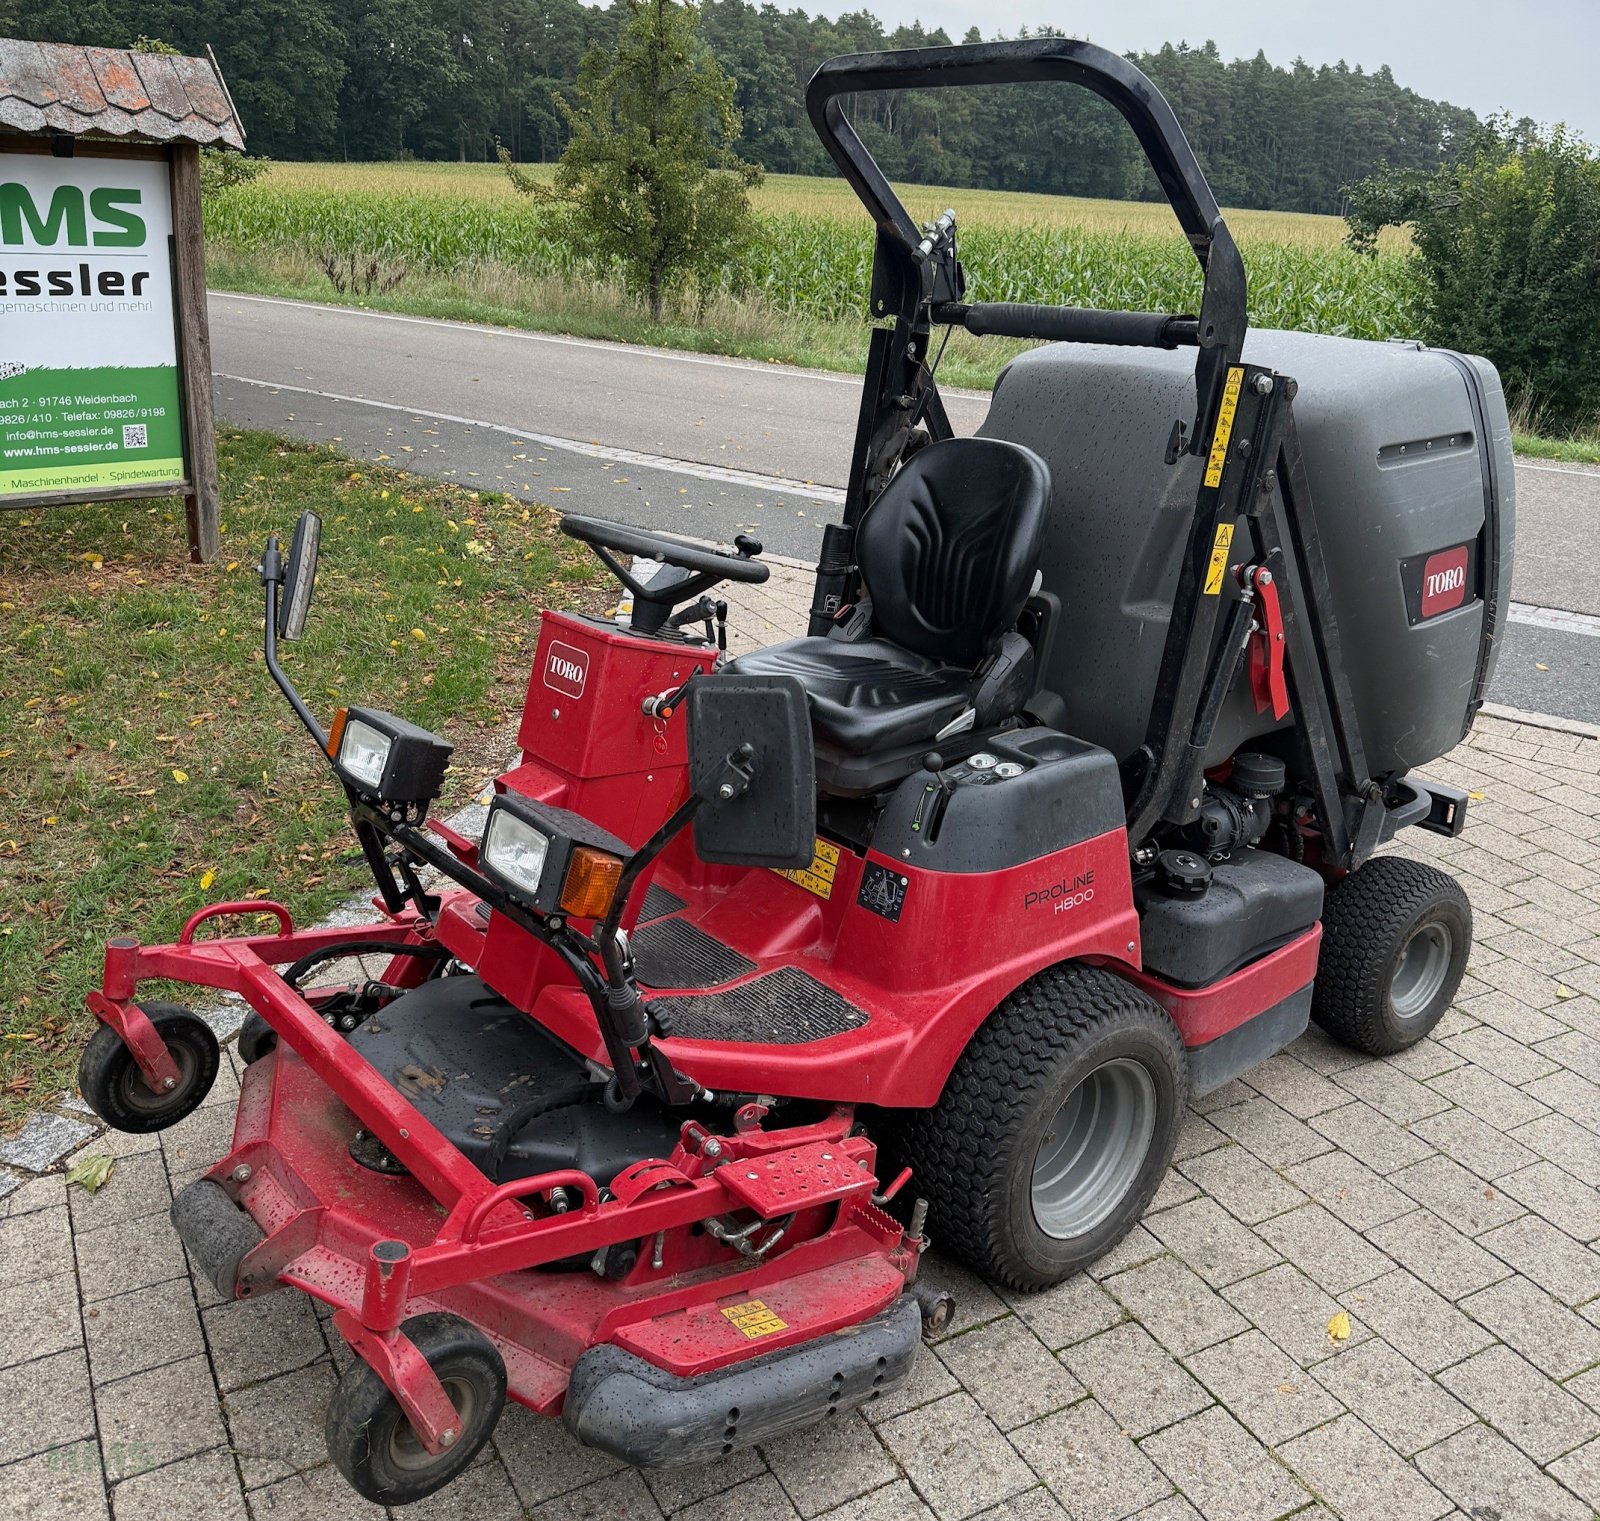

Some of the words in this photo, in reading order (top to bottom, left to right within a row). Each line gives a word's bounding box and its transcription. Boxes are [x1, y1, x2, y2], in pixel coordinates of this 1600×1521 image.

[90, 301, 114, 313] und
[118, 301, 153, 313] mehr!
[22, 398, 29, 408] 2
[38, 396, 72, 408] 91746
[74, 393, 138, 406] Weidenbach
[61, 411, 101, 423] Telefax:
[104, 407, 166, 420] 09826/9198
[6, 426, 114, 441] info@hms-sessler.de
[4, 441, 119, 458] www.hms-sessler.de
[11, 473, 99, 489] Maschinenhandel
[109, 467, 181, 481] Spindelwartung
[1427, 566, 1464, 598] TORO
[550, 655, 582, 684] TORO
[1054, 888, 1094, 915] H800
